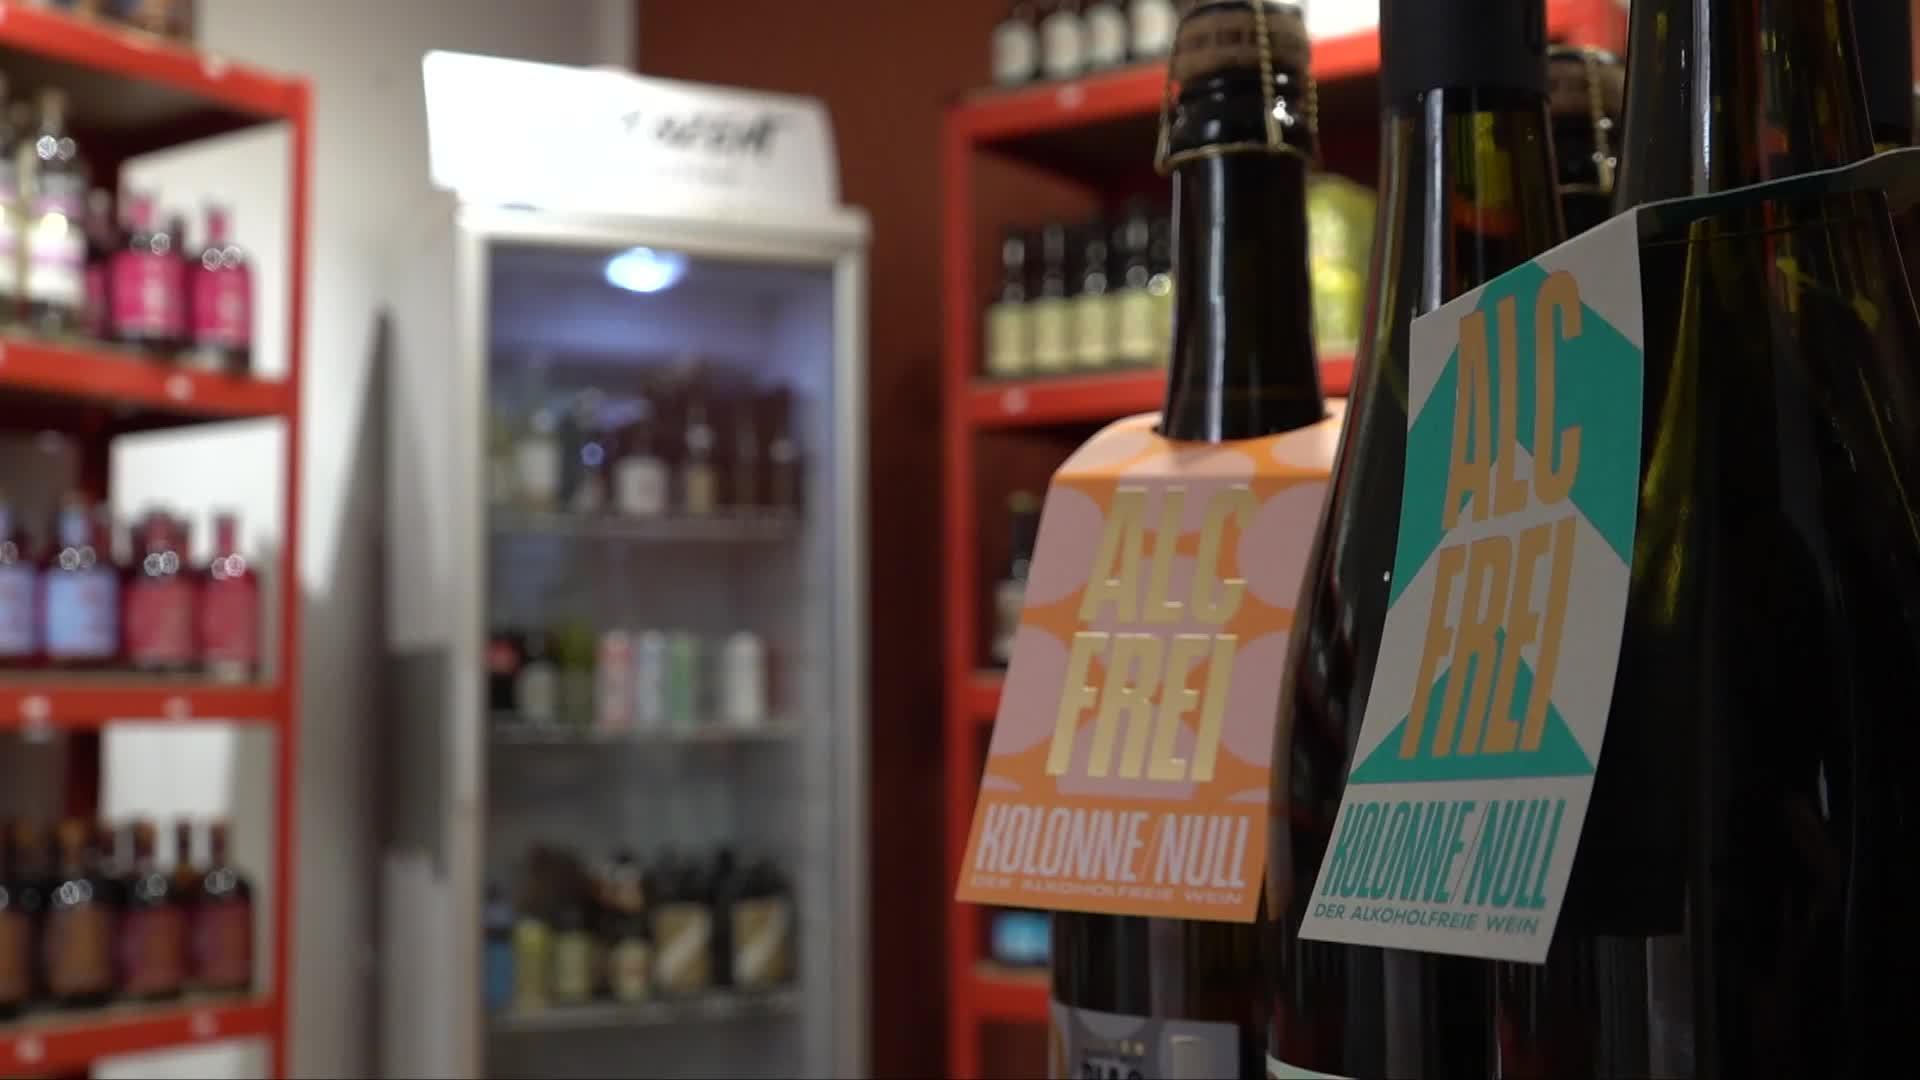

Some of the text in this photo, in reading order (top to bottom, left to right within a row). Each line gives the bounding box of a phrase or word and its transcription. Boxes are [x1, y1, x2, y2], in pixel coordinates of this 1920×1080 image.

[1441, 269, 1583, 531] ALC
[1079, 484, 1257, 625] ALC
[1046, 631, 1238, 781] FREI
[1397, 516, 1577, 759] FREI
[1313, 903, 1539, 935] DER ALKOHOLFREIE WEIN
